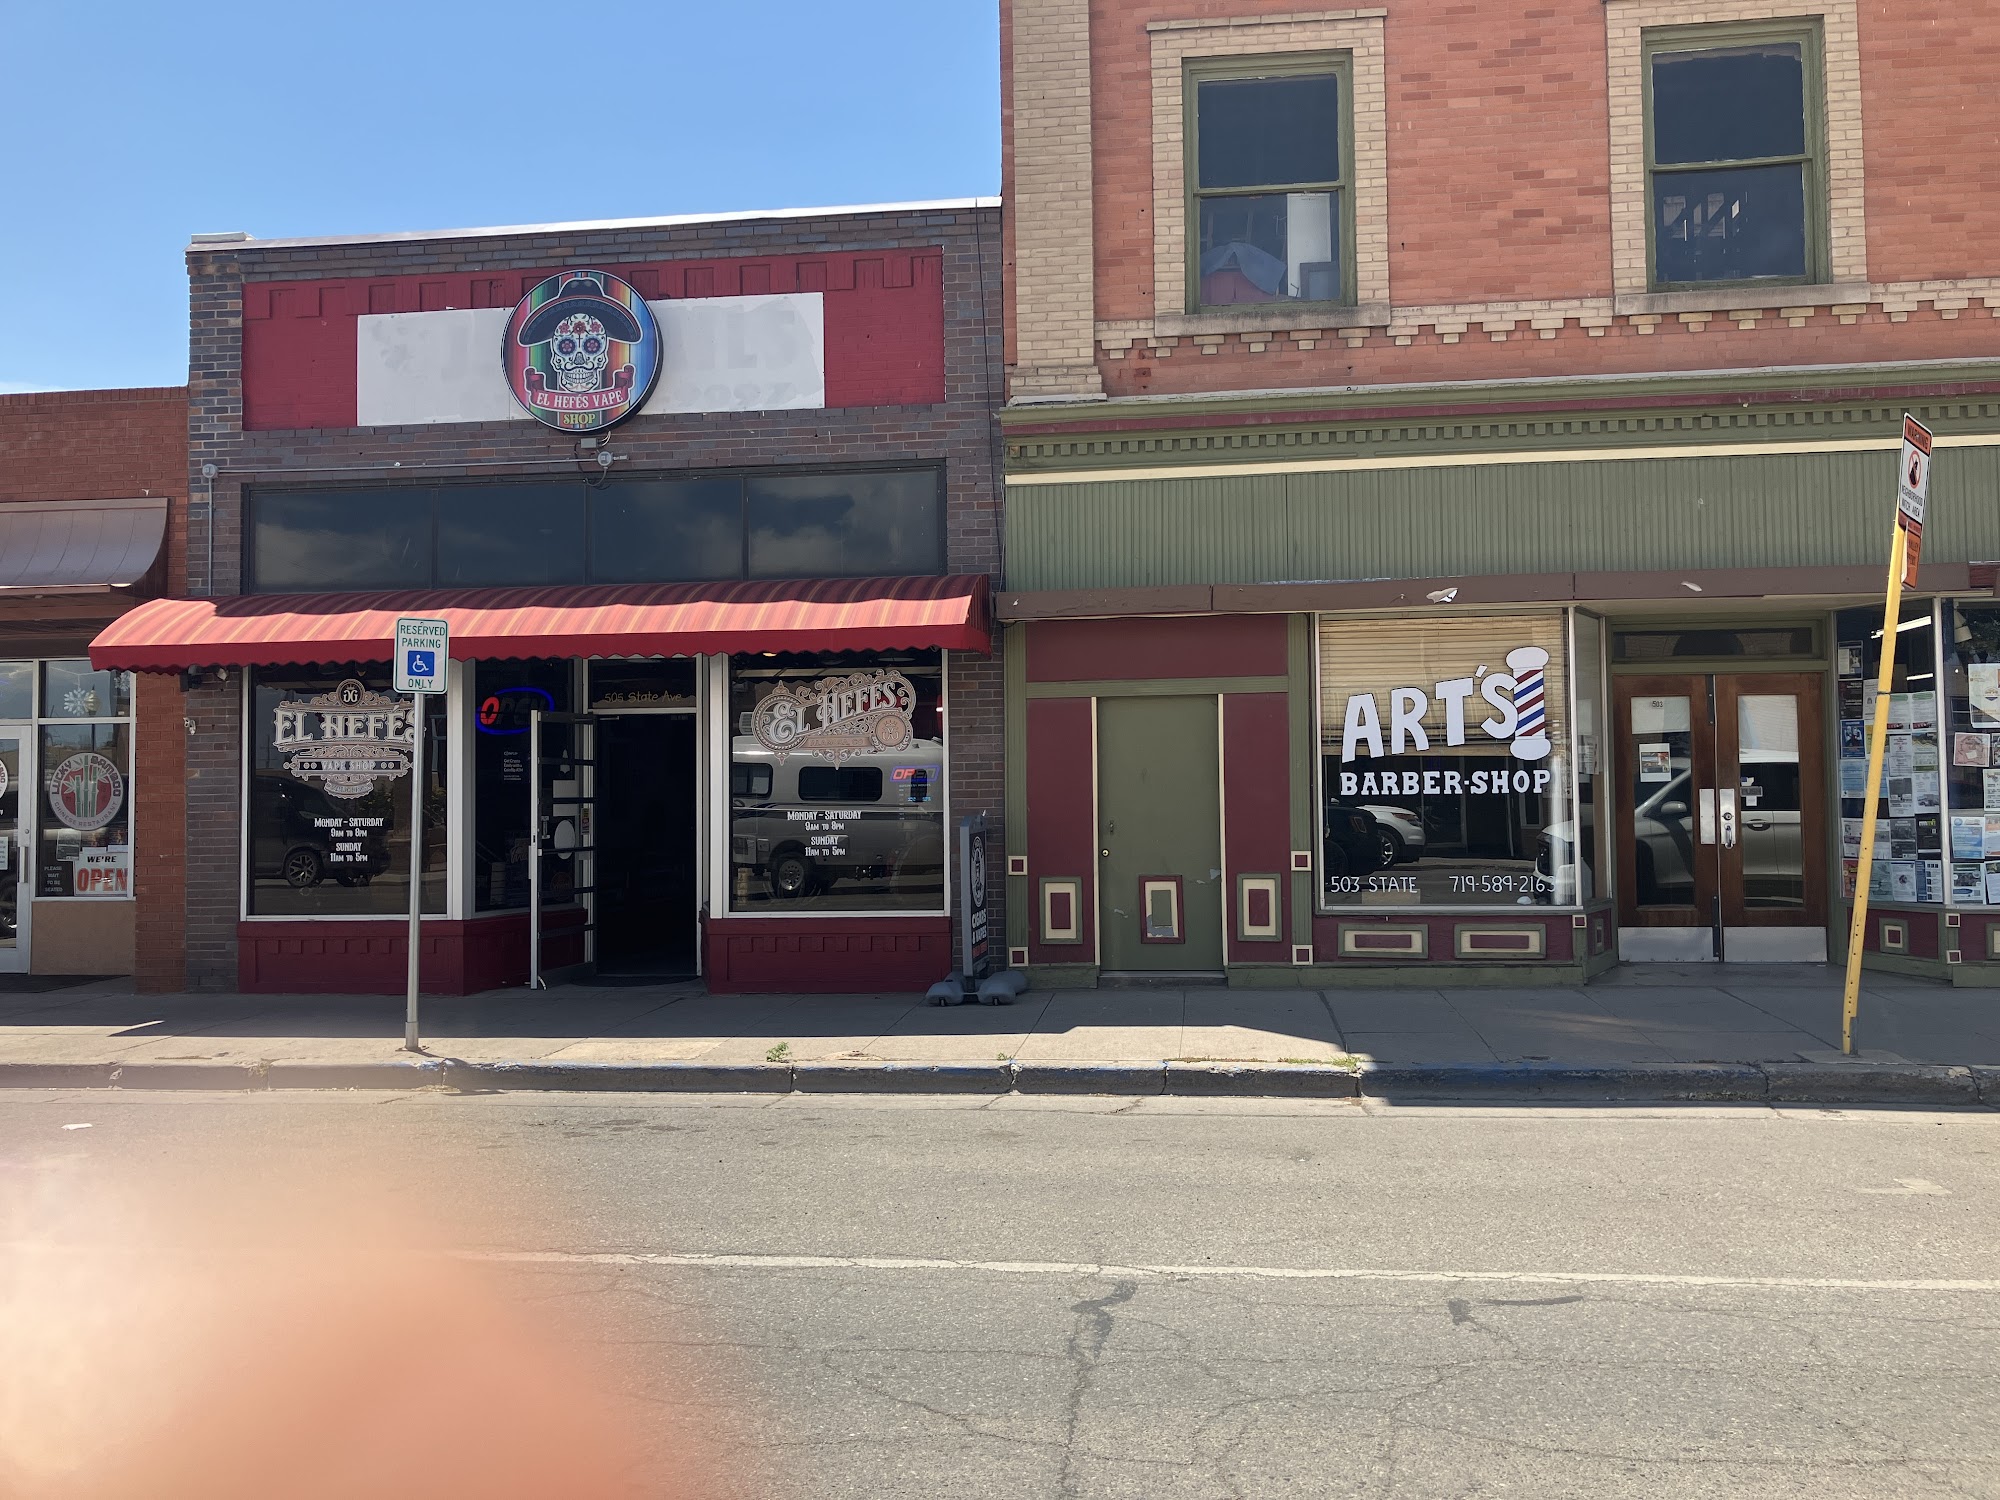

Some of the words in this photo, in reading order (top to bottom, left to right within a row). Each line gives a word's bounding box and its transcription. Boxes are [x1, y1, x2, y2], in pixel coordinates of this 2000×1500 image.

[536, 393, 550, 406] EL
[553, 393, 589, 409] HEFÉS
[592, 390, 624, 407] VAPE
[563, 412, 596, 424] SHOP
[400, 624, 446, 636] RESERVED
[401, 637, 441, 648] PARKING
[408, 679, 433, 688] ONLY
[604, 691, 624, 703] 505
[628, 690, 659, 704] State
[662, 690, 682, 703] Ave
[1342, 664, 1519, 763] ART'S
[273, 707, 314, 747] EL
[769, 701, 811, 744] EL
[321, 761, 346, 771] VAPE
[349, 761, 376, 771] SHOP
[52, 760, 72, 795] LUCKY
[90, 755, 121, 797] BAMBOO
[892, 768, 937, 780] OPEN
[1340, 770, 1552, 795] BARBER-SHOP
[54, 801, 77, 826] CHINESE
[78, 801, 119, 828] RESTAURANT
[787, 811, 818, 820] MONDAY
[825, 811, 861, 820] SATURDAY
[314, 818, 342, 827] MONDAY
[349, 817, 384, 827] SATURDAY
[805, 821, 819, 831] 9AM
[832, 821, 844, 830] 8PM
[330, 828, 344, 837] 9AM
[355, 828, 367, 837] 8PM
[336, 842, 362, 851] SUNDAY
[811, 836, 839, 845] SUNDAY
[330, 853, 344, 862] 11AM
[355, 852, 368, 862] 5PM
[805, 846, 819, 856] 11AM
[822, 848, 829, 856] TO
[832, 846, 845, 856] 5PM
[87, 855, 117, 863] WE'RE
[77, 868, 128, 892] OPEN
[1331, 876, 1360, 893] 503
[1368, 876, 1418, 893] STATE
[1449, 875, 1557, 893] 719-589-2163
